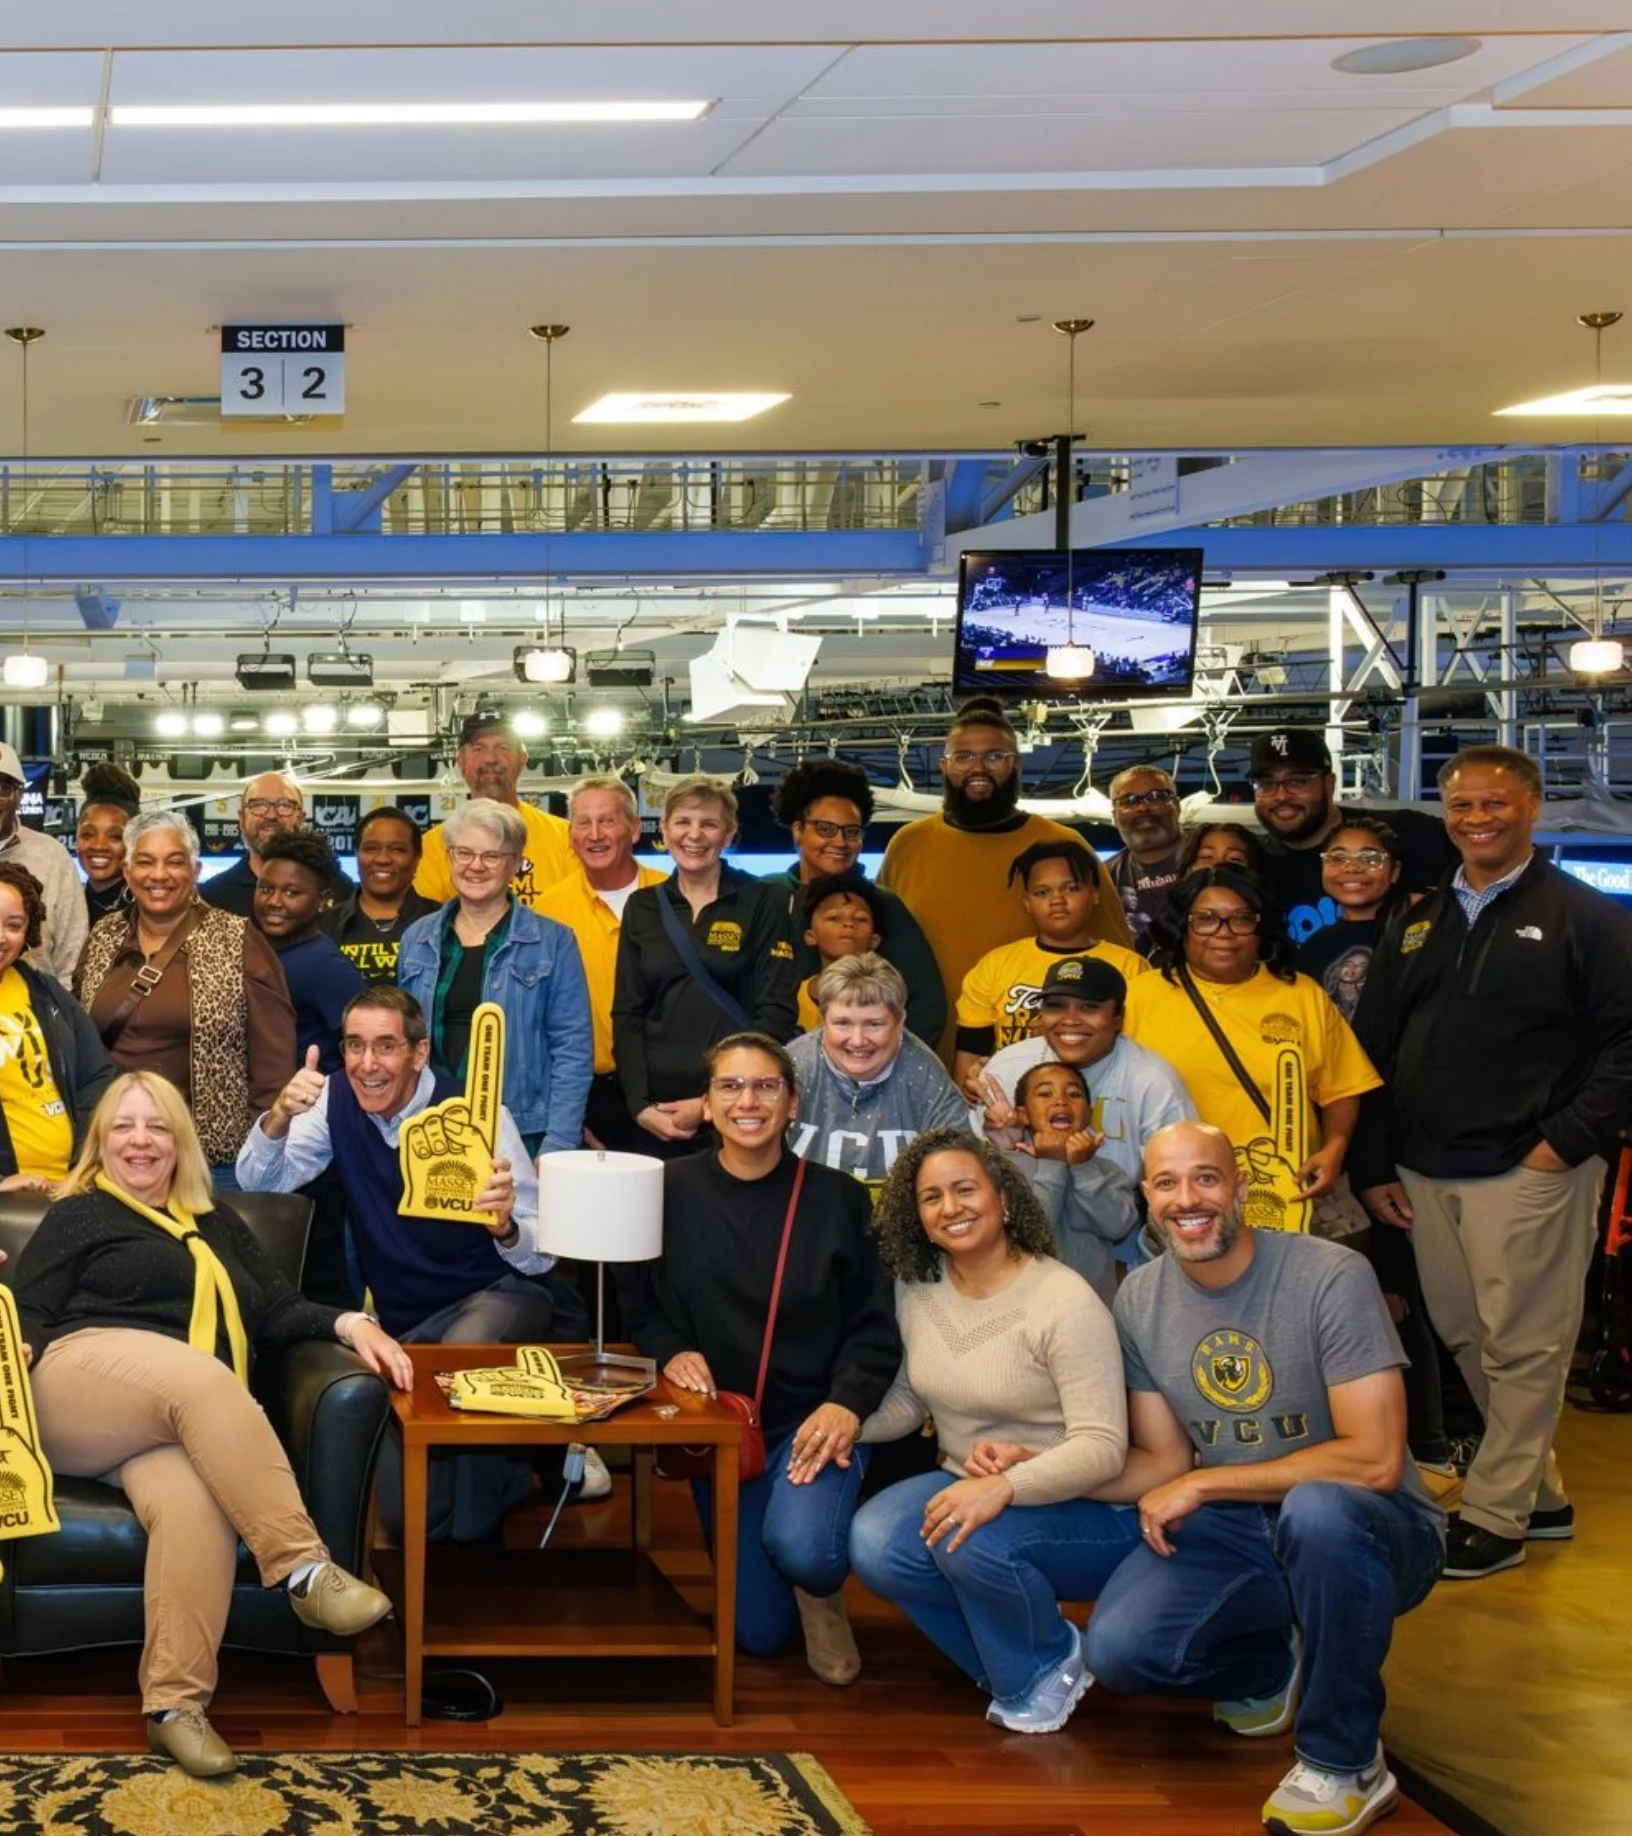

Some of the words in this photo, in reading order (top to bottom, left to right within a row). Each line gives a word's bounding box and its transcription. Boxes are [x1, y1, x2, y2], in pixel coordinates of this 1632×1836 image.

[237, 331, 327, 348] SECTION
[240, 367, 264, 399] 3
[302, 367, 326, 399] 2
[1573, 866, 1597, 884] The
[1597, 867, 1632, 890] Good
[1005, 984, 1043, 1014] Te
[485, 1024, 493, 1043] ONE
[483, 1046, 491, 1071] TEAM
[1285, 1061, 1293, 1078] ONE
[481, 1073, 489, 1092] ONE
[1285, 1081, 1293, 1105] TEAM
[479, 1094, 488, 1122] FIGHT
[1285, 1108, 1293, 1125] ONE
[1285, 1128, 1293, 1152] FIGHT
[427, 1176, 476, 1189] MASSEY
[439, 1197, 473, 1212] VCU
[1247, 1203, 1285, 1217] ASSEY
[1199, 1333, 1257, 1356] RAMS
[1, 1364, 13, 1386] ONE
[6, 1389, 19, 1419] FIGHT
[1190, 1412, 1309, 1446] VCU
